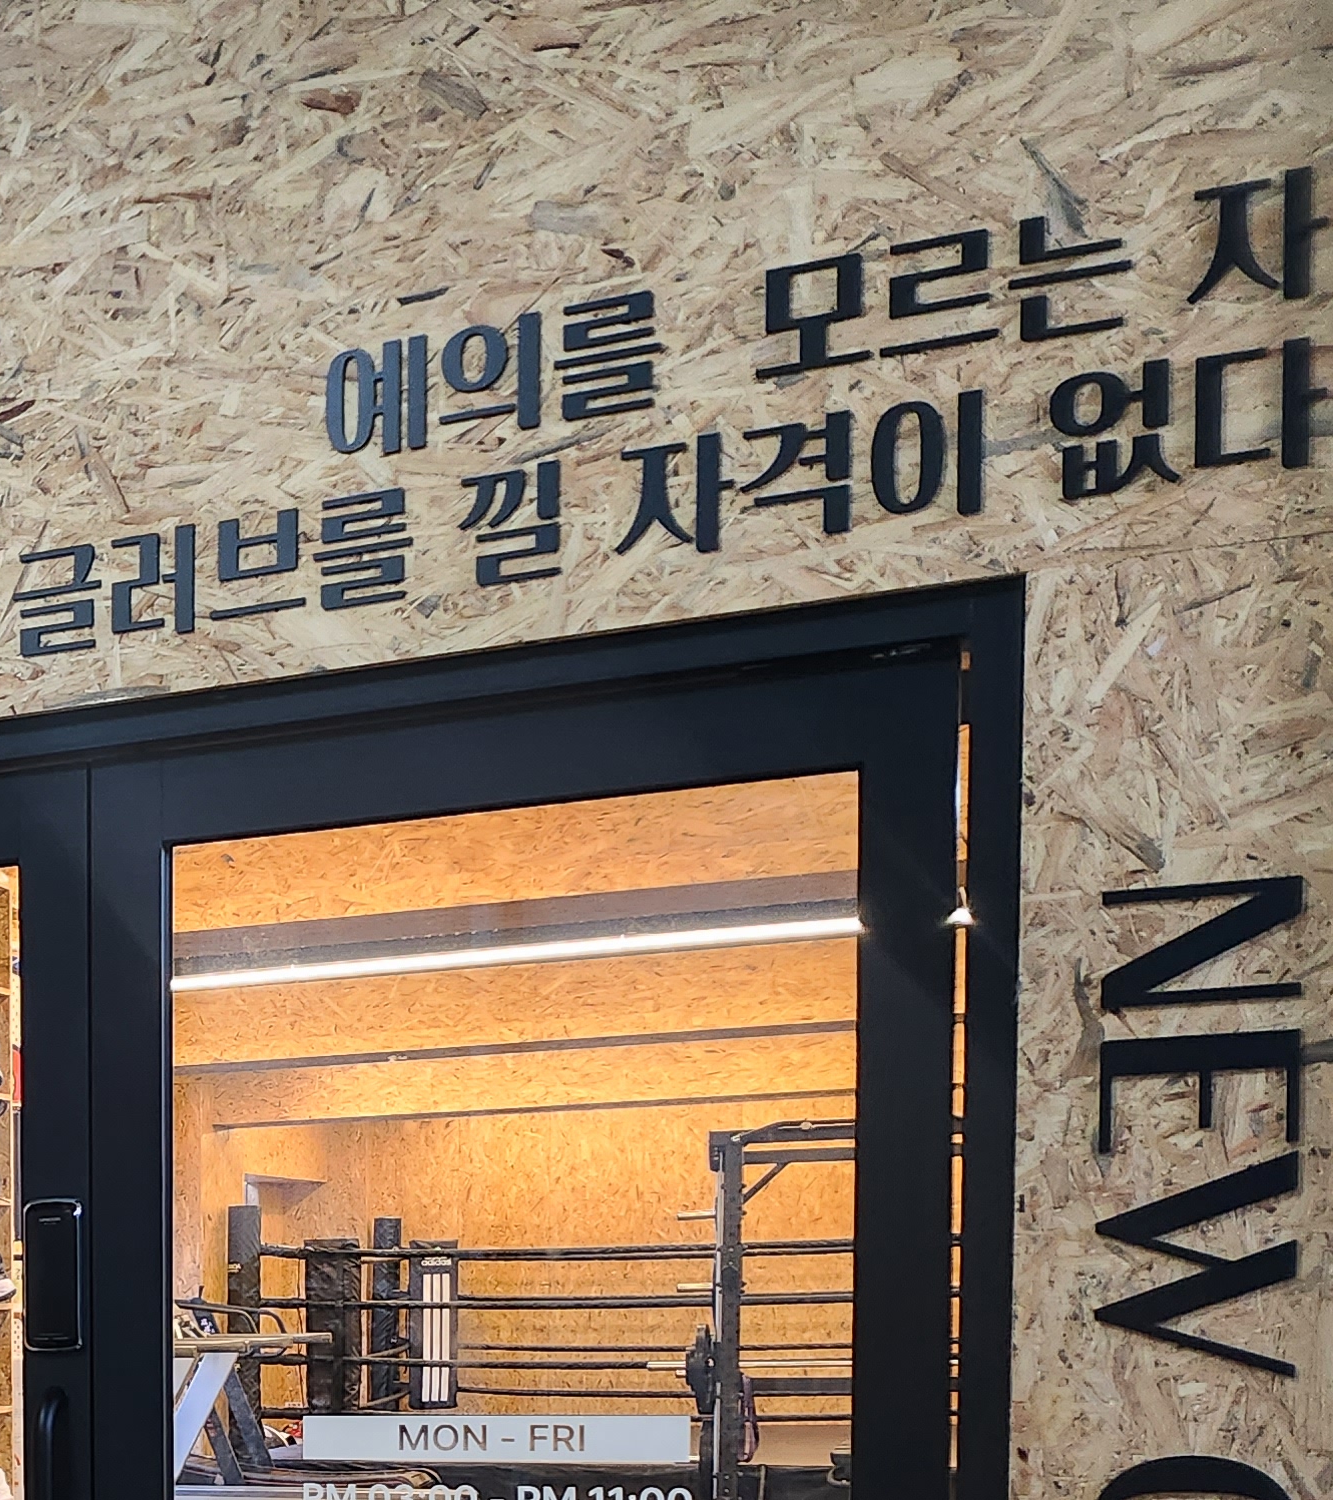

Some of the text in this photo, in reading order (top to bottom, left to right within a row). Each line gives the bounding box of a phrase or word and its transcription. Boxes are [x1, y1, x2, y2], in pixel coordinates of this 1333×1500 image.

[326, 165, 1330, 455] 예의를 모르는 자
[12, 336, 1330, 657] 글러브를 낄 자격이 없다
[1093, 874, 1304, 1379] NEW
[398, 1424, 487, 1452] MON
[530, 1424, 586, 1452] FRI
